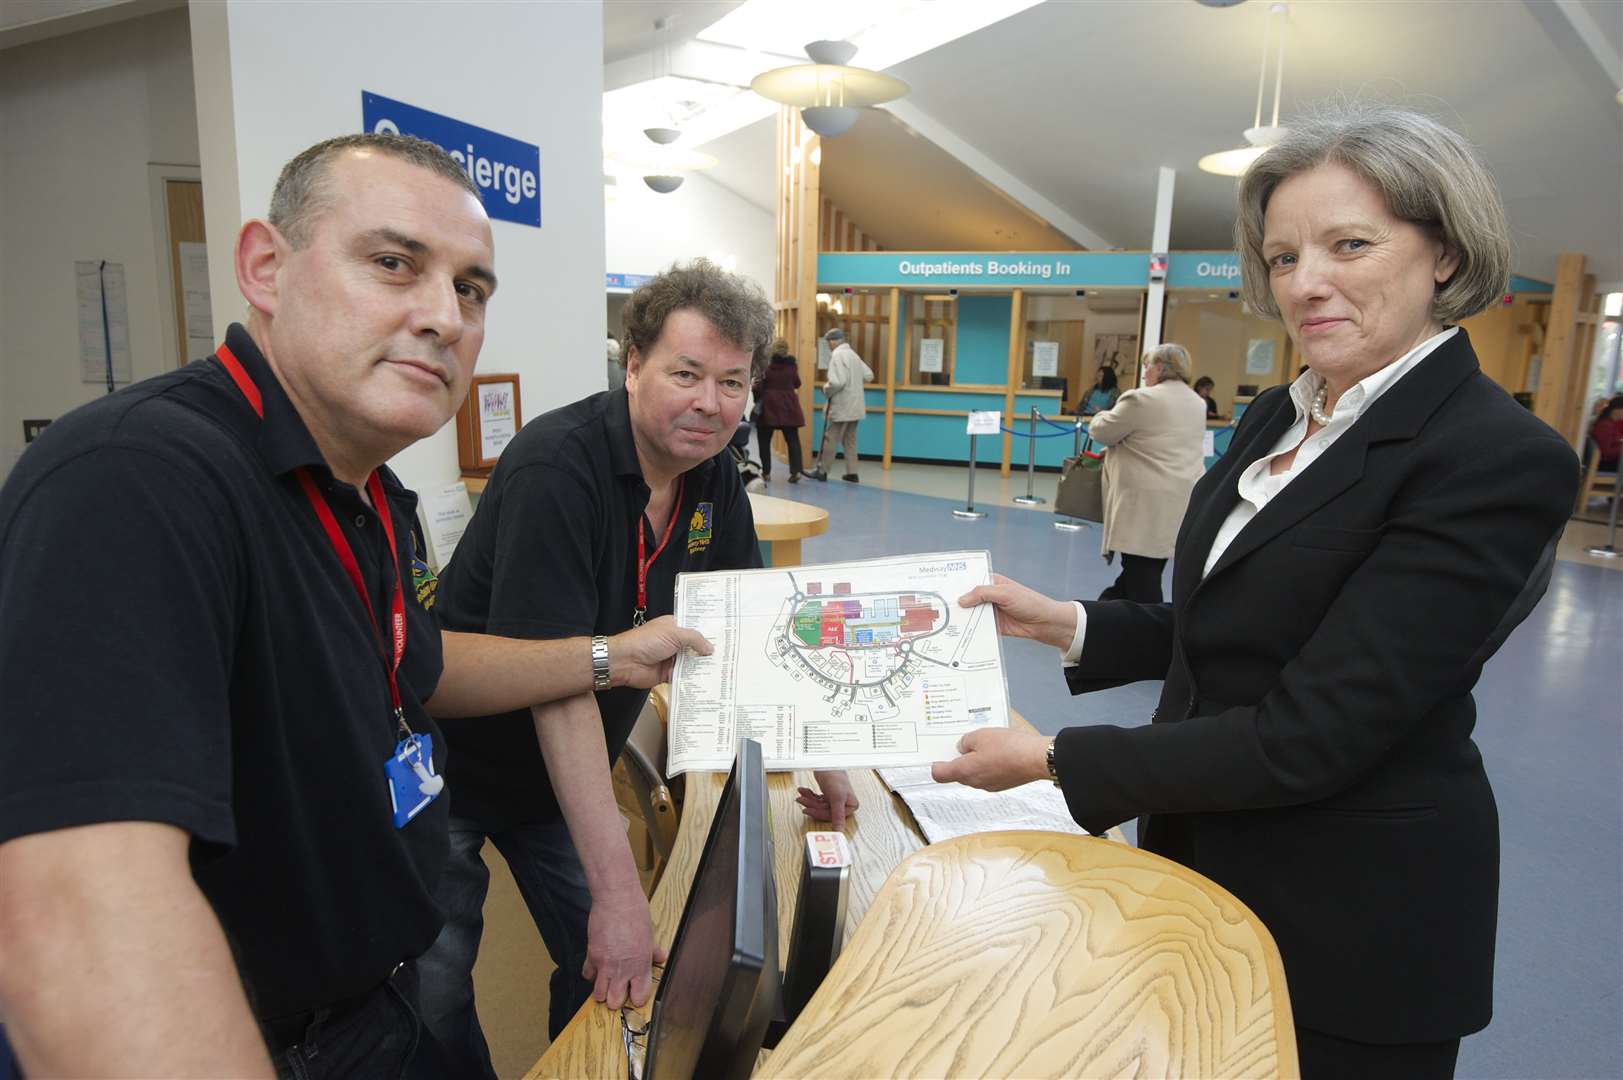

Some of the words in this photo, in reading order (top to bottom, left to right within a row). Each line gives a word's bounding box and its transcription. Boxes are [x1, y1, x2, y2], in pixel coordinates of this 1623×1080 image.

[374, 118, 537, 204] ierge
[899, 260, 983, 277] Outpatients
[987, 260, 1052, 278] Booking
[1055, 261, 1071, 275] In
[393, 613, 405, 654] VOLUNTEER
[815, 834, 838, 865] STP
